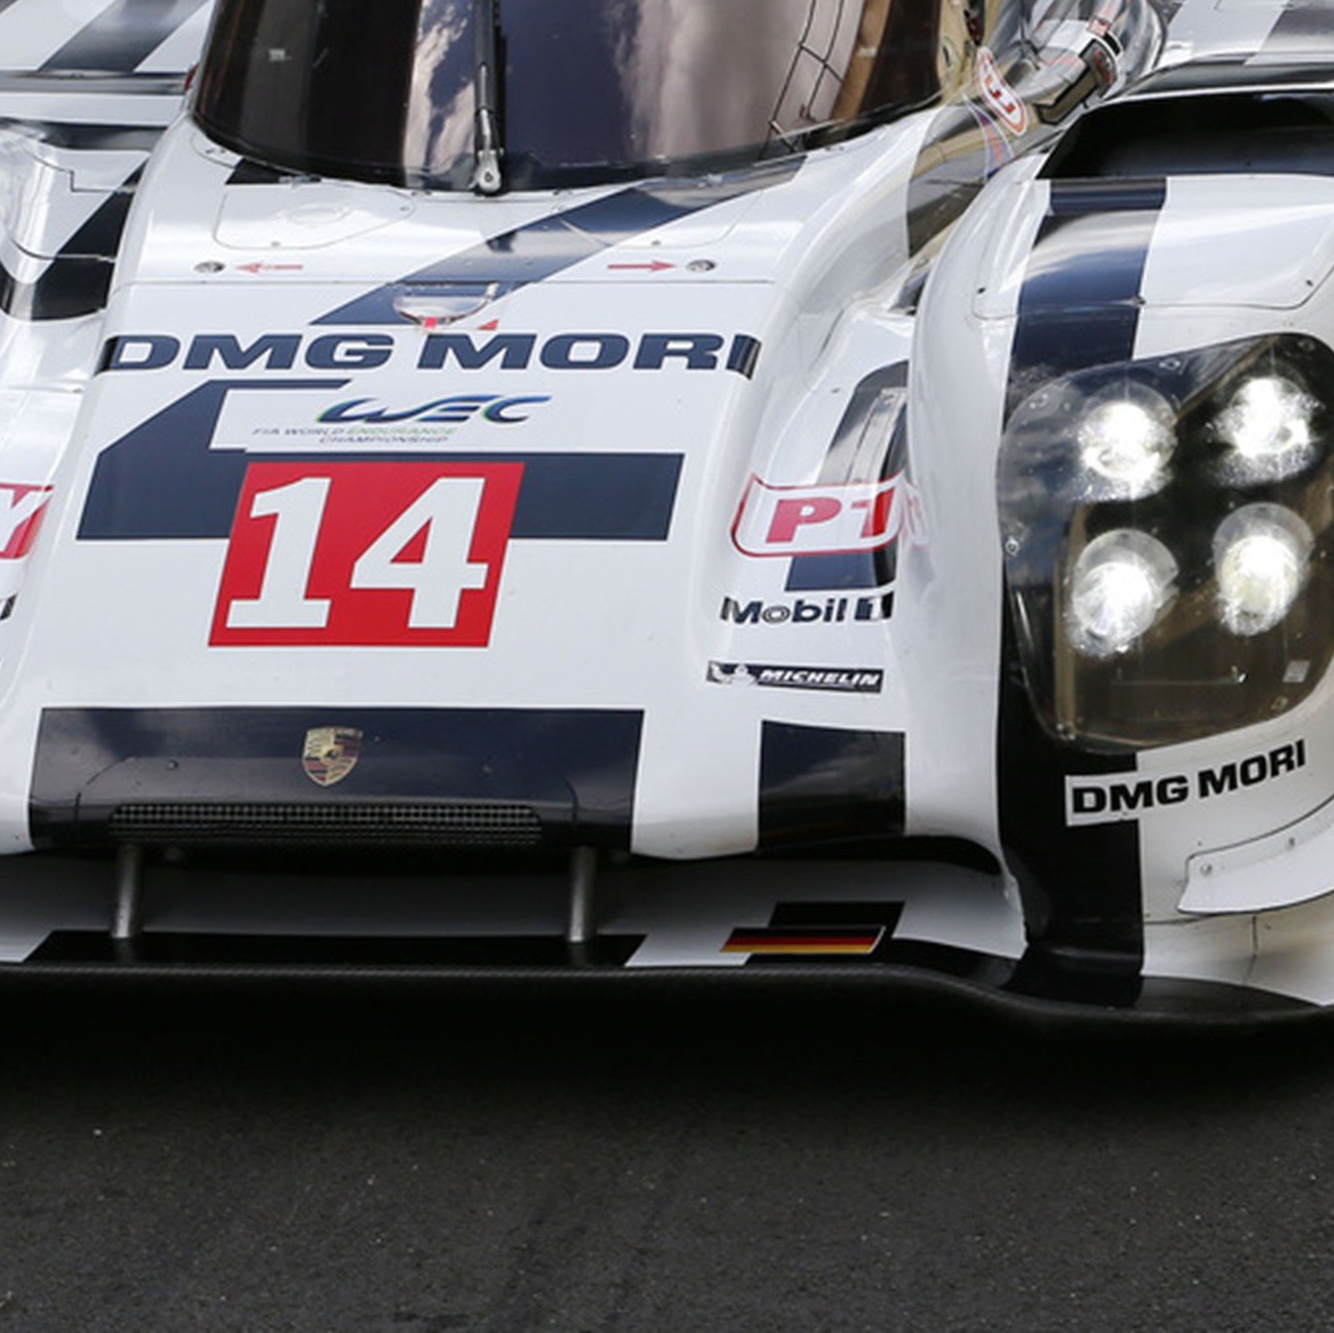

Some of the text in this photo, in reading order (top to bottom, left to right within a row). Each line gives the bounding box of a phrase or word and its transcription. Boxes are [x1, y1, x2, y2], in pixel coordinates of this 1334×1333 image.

[94, 332, 761, 380] DMG MORI
[317, 394, 552, 424] WEC
[765, 487, 895, 544] P1
[224, 476, 490, 631] 14
[720, 596, 848, 625] Mobil
[759, 669, 881, 686] MICHELIN
[1072, 739, 1306, 815] DMG MORI
